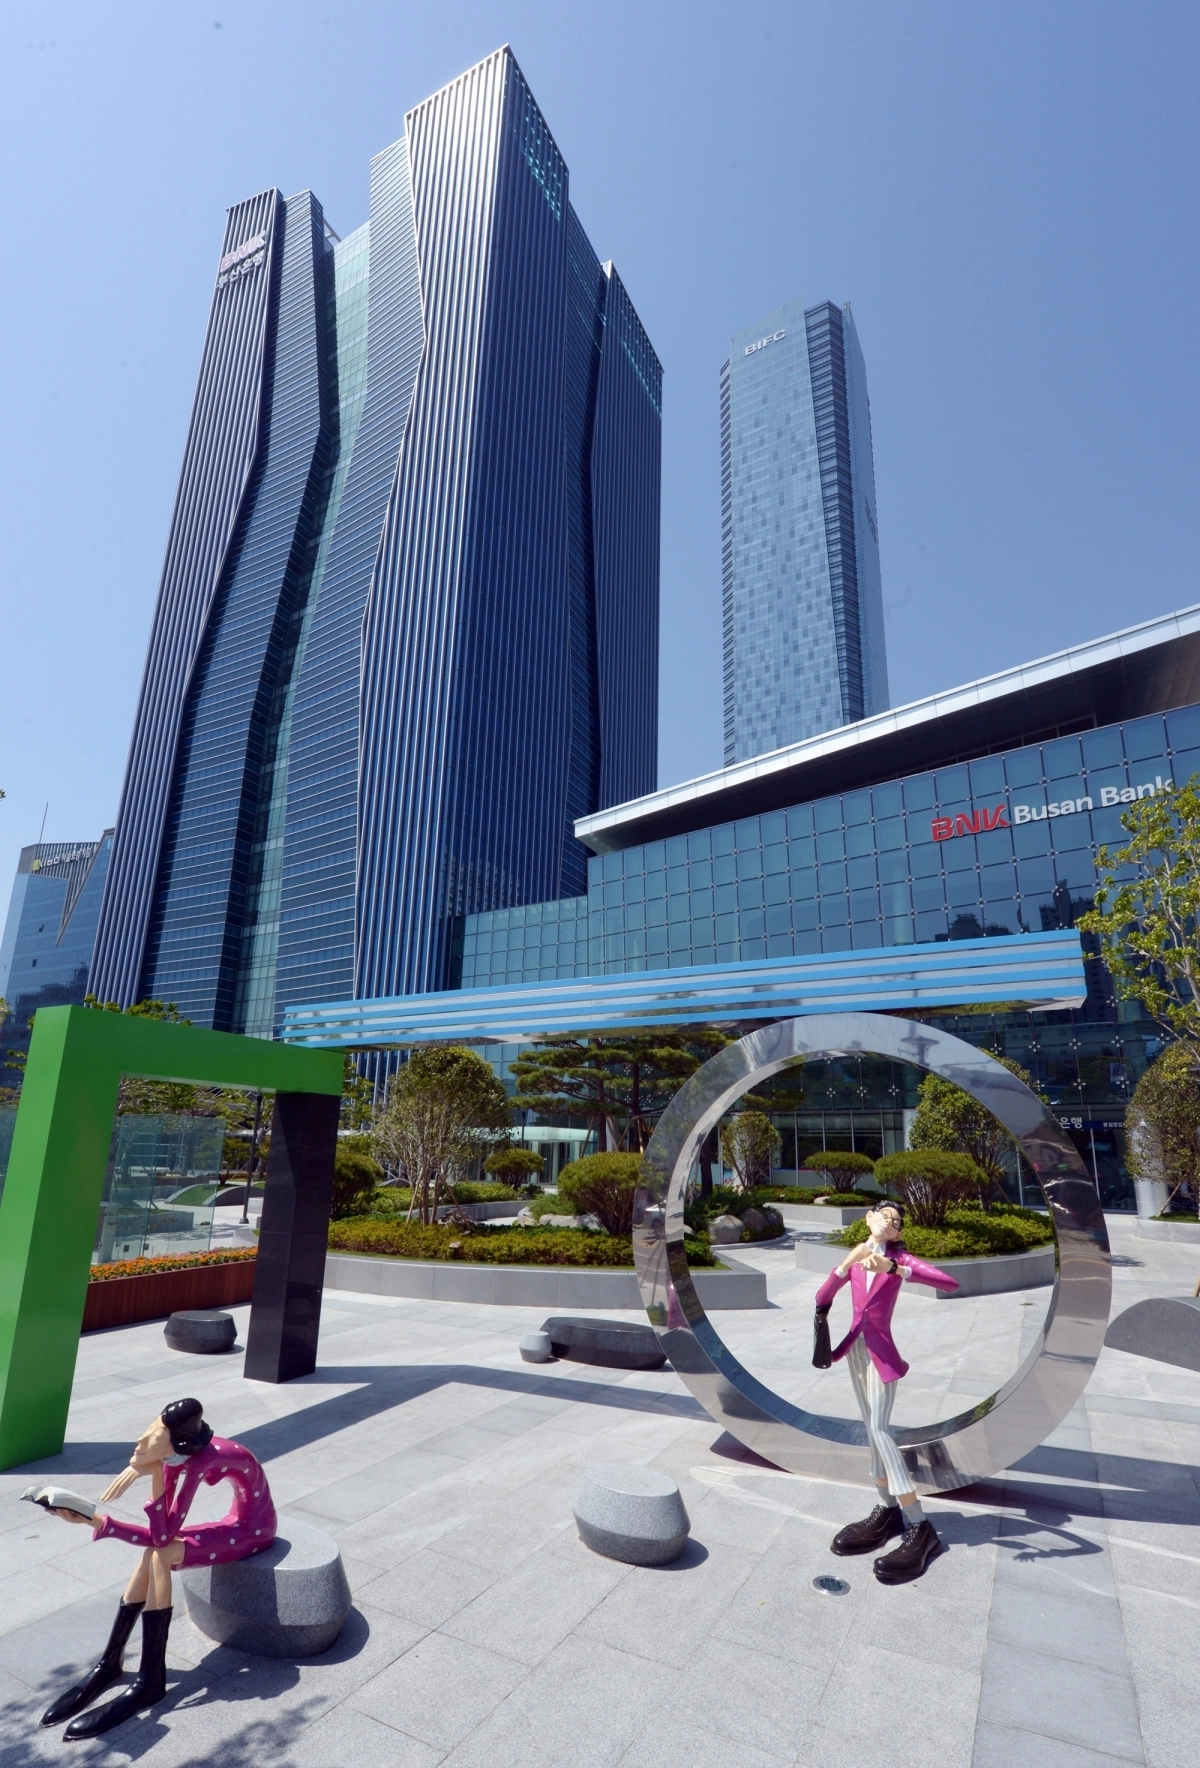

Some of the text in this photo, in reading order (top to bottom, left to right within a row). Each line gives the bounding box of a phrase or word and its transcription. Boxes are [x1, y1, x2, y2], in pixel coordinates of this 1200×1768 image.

[217, 249, 264, 289] 부산은행
[220, 230, 267, 273] BNK
[744, 329, 786, 356] BIFC
[931, 775, 1174, 842] BNK Busan Bank
